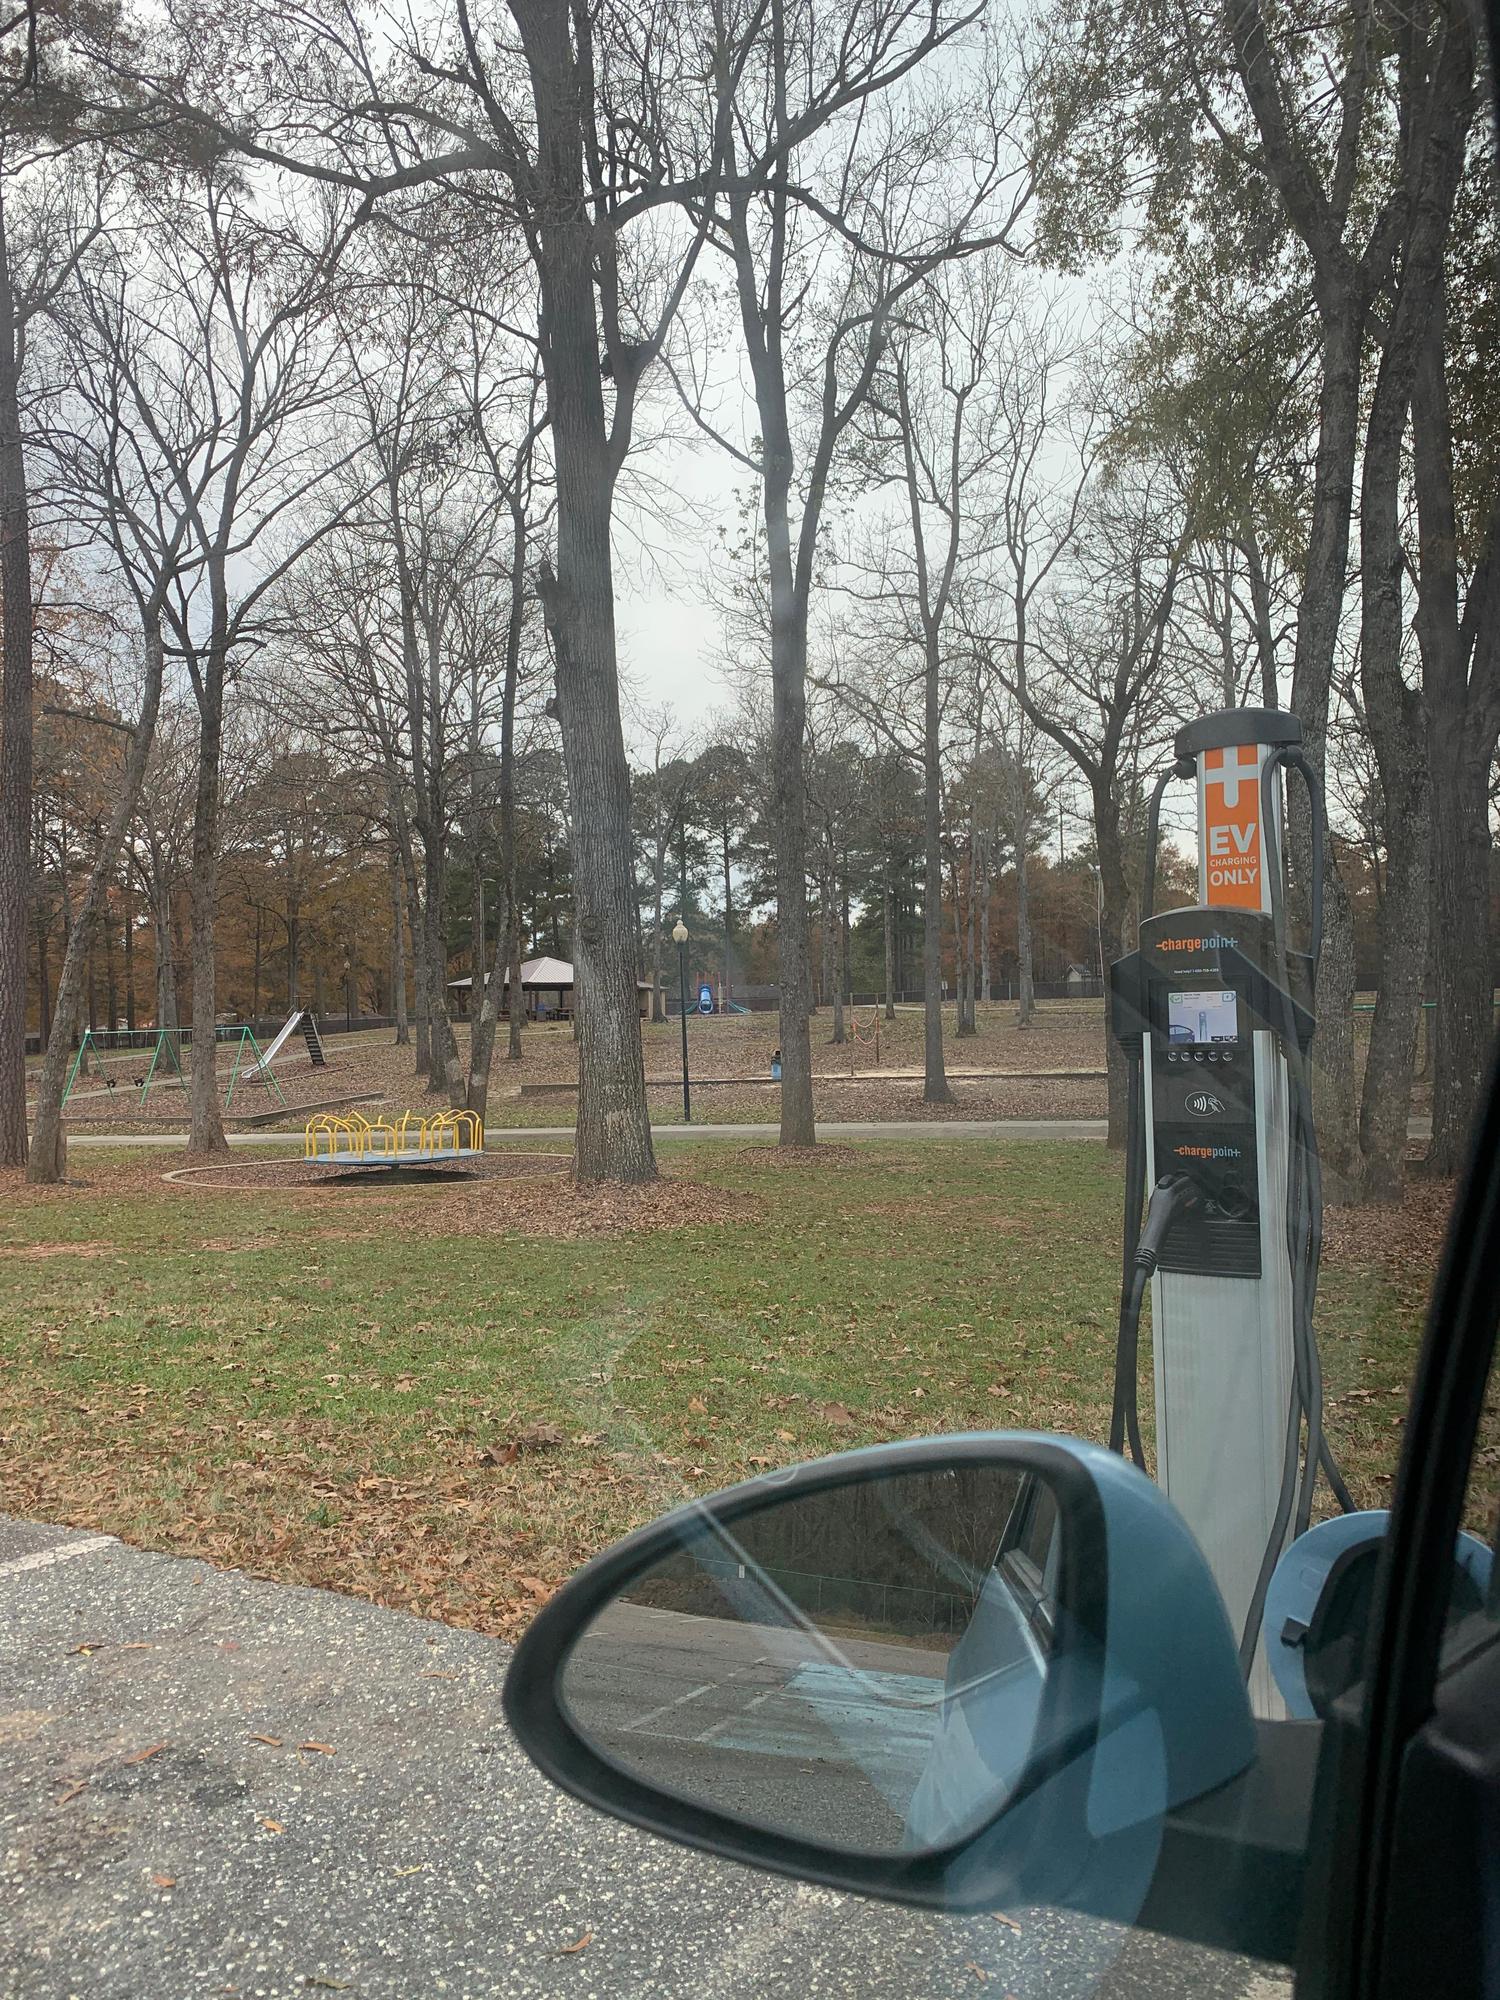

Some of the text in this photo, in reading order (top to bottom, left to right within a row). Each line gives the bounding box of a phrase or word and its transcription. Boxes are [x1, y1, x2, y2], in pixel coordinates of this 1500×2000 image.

[1210, 823, 1256, 856] EV
[1210, 856, 1257, 867] CHARGING
[1210, 868, 1258, 887] ONLY
